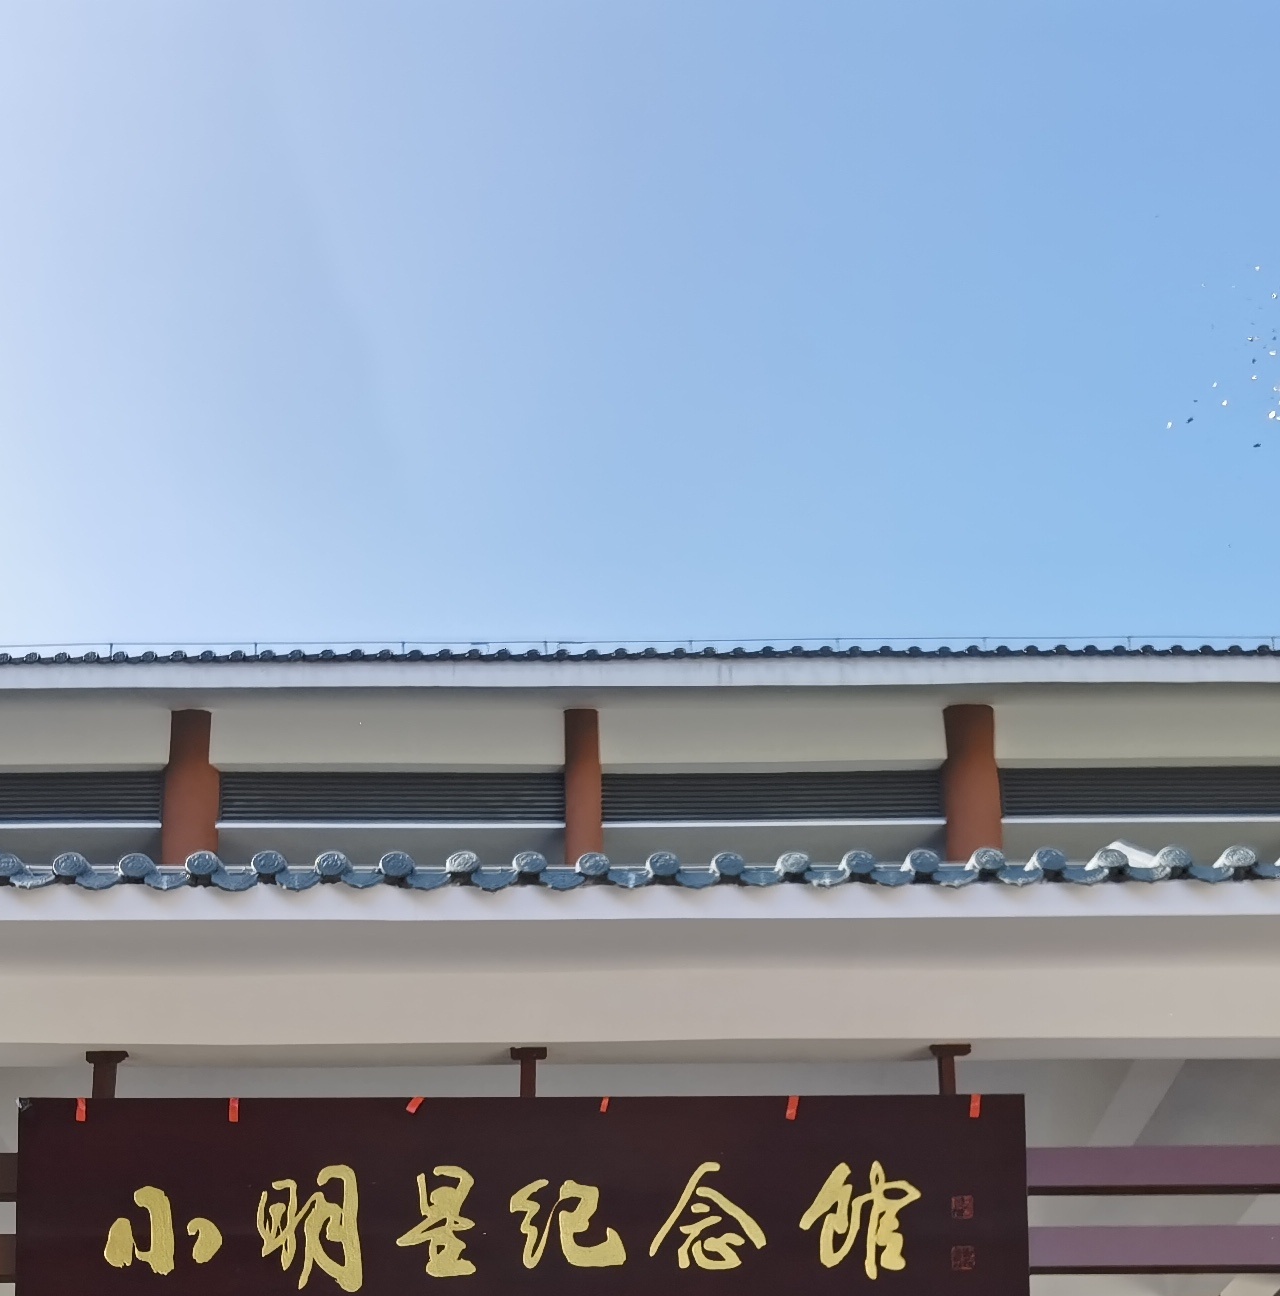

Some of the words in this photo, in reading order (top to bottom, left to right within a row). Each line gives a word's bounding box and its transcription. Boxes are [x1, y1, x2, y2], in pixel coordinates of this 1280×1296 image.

[104, 1161, 922, 1292] 小明星纪念馆
